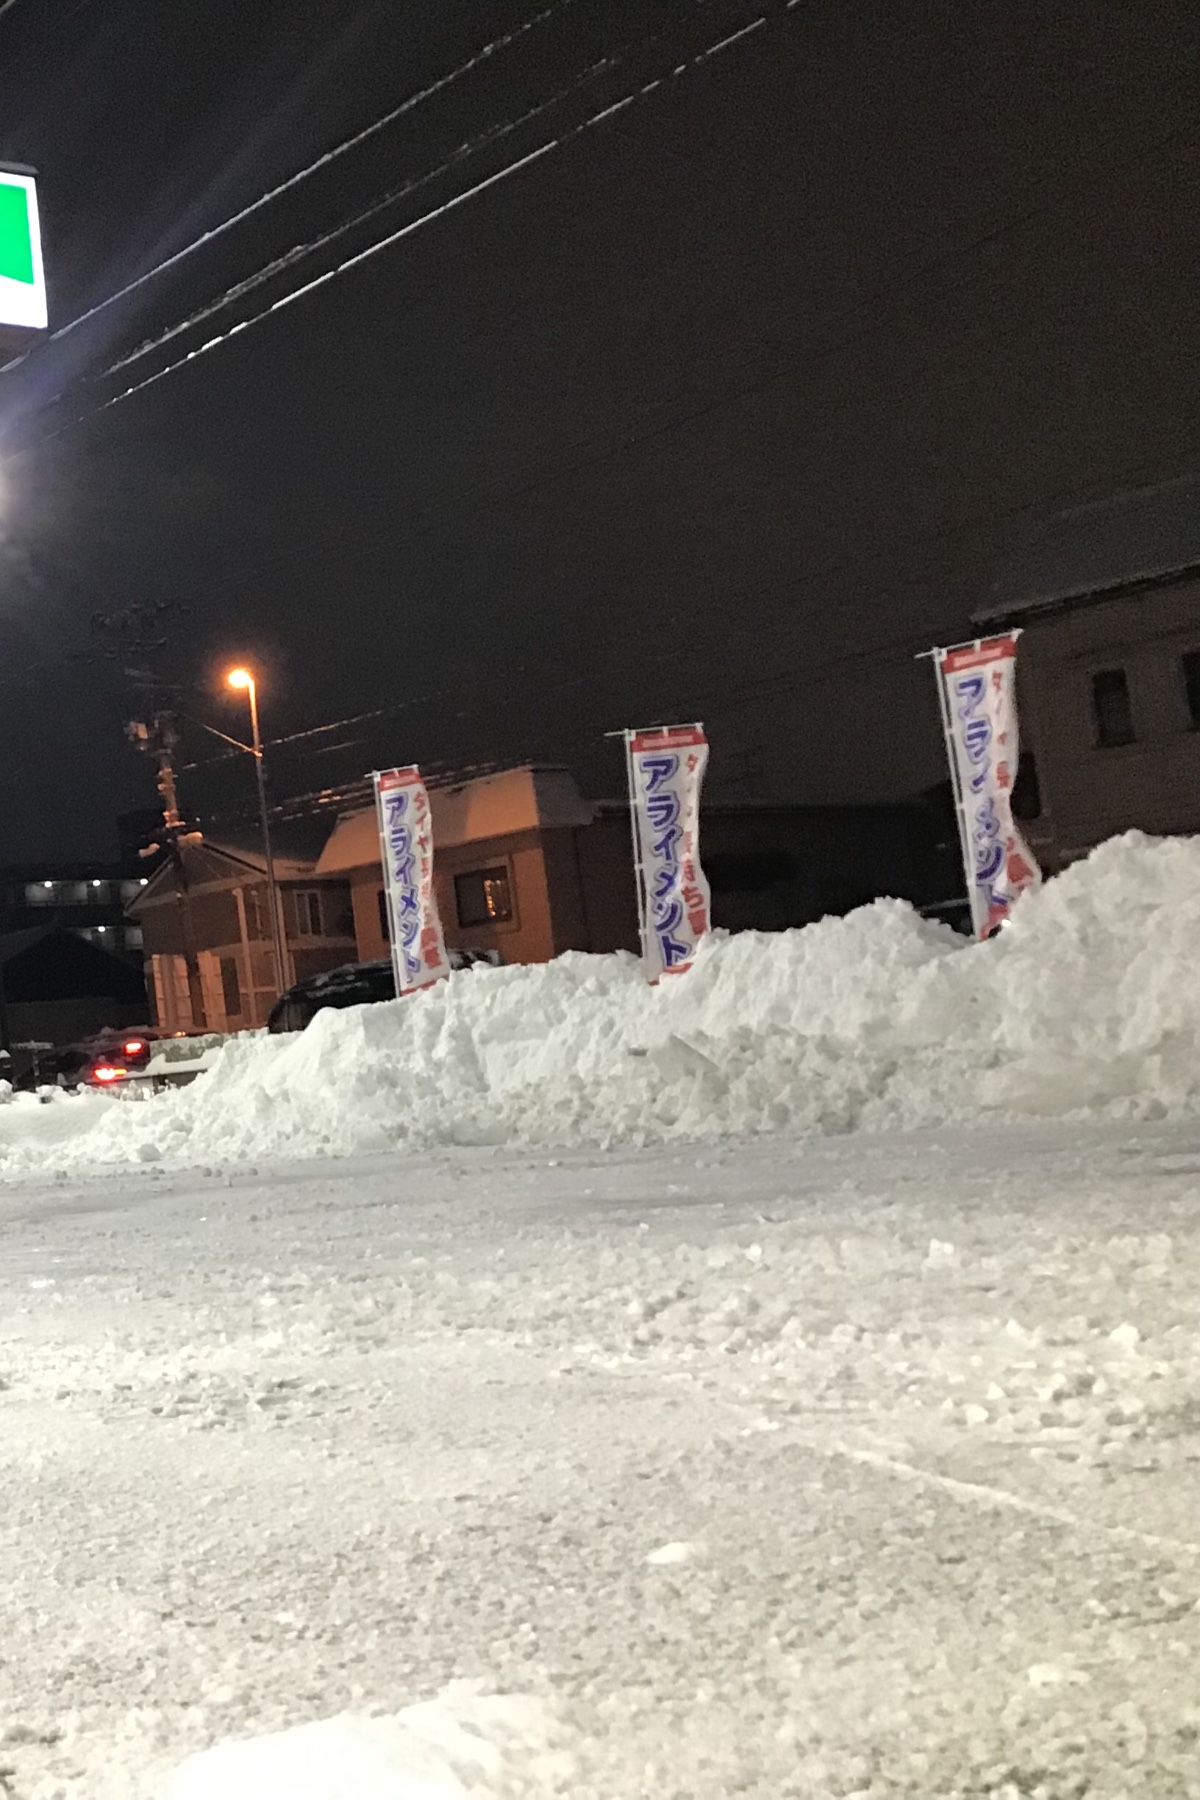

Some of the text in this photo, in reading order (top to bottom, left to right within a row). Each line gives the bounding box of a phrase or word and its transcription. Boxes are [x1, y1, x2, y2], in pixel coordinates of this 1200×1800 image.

[385, 791, 423, 984] アライメント
[641, 755, 692, 968] アライメント
